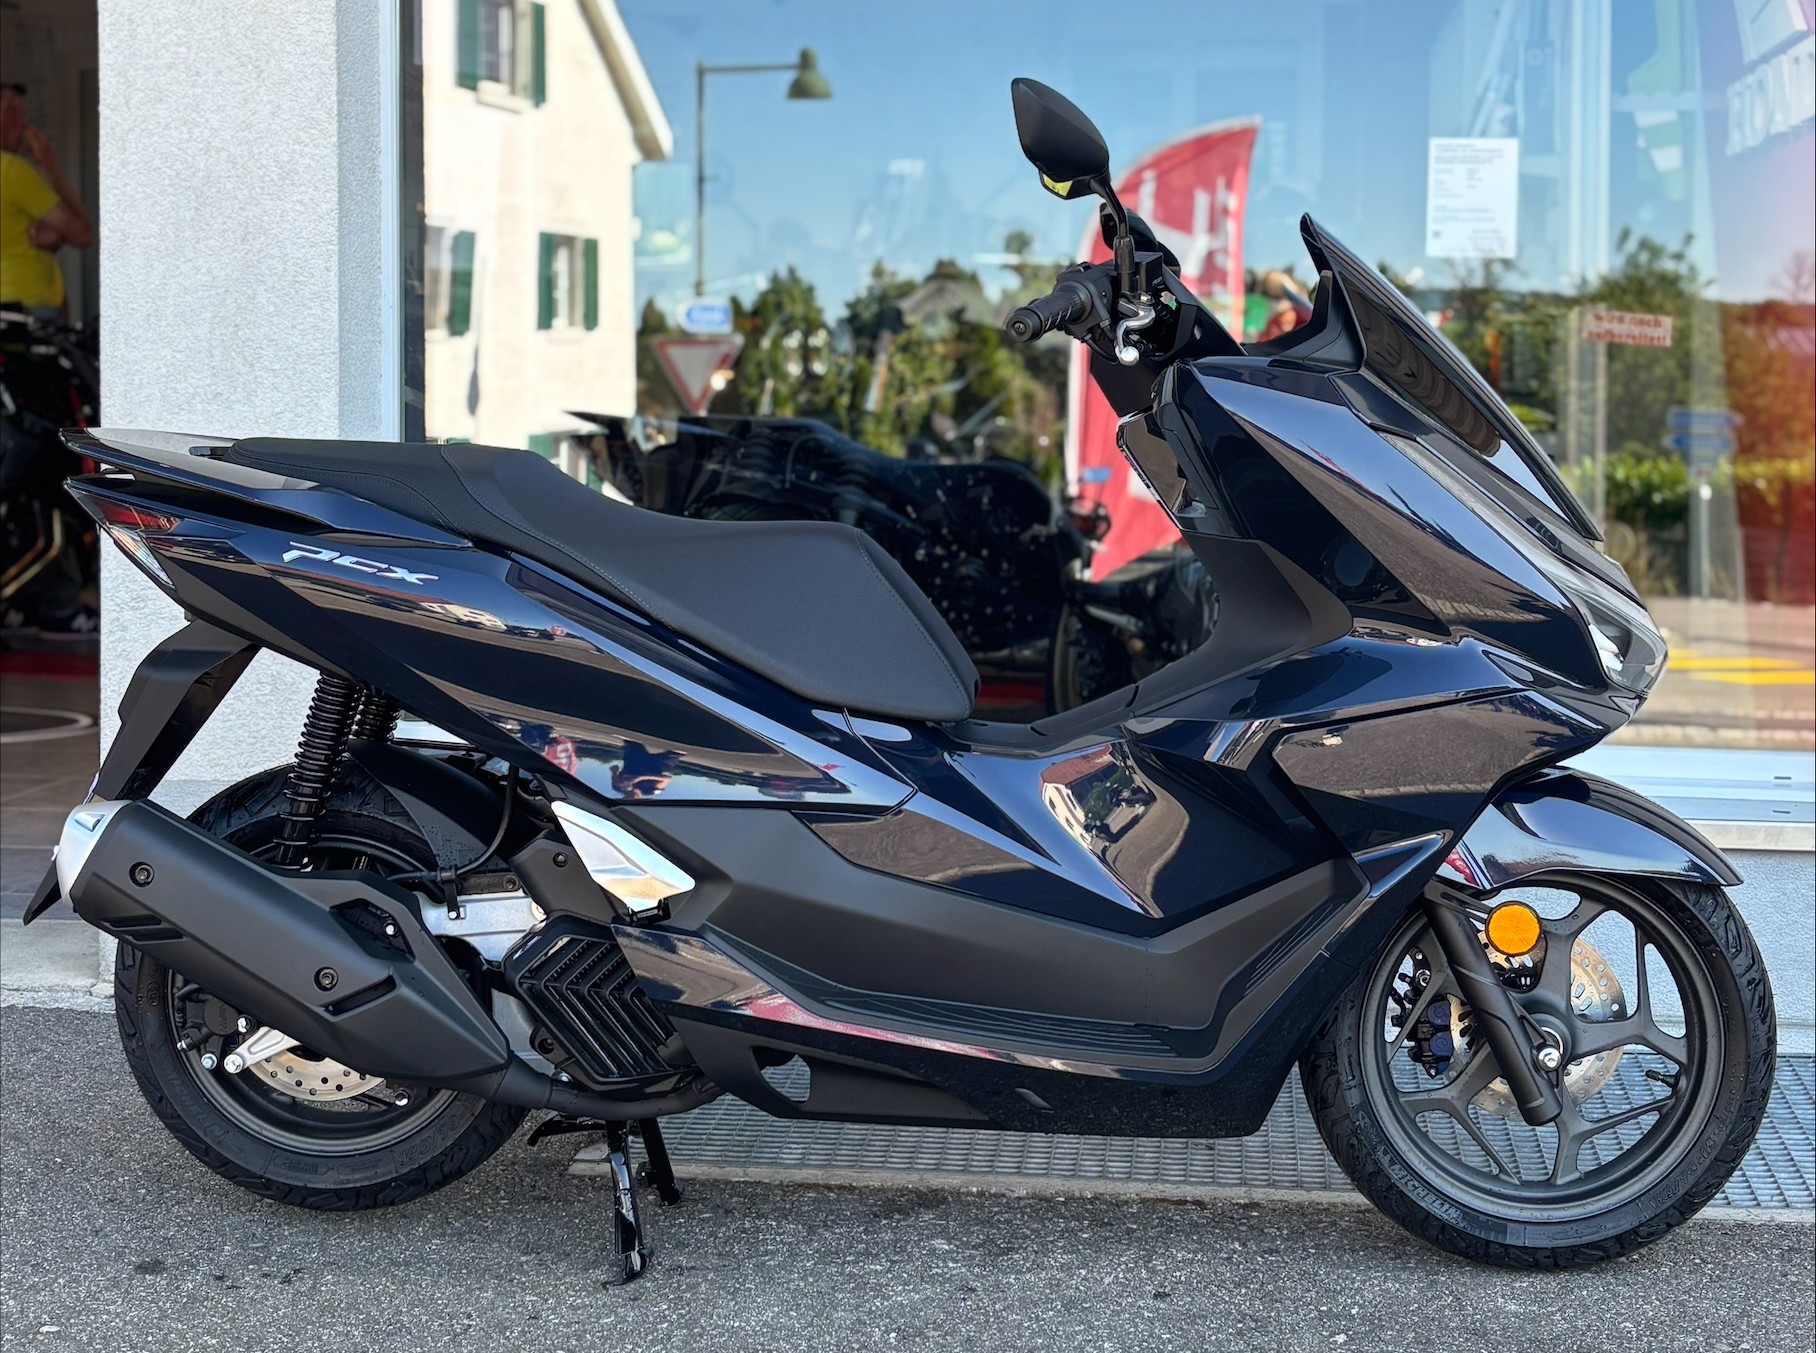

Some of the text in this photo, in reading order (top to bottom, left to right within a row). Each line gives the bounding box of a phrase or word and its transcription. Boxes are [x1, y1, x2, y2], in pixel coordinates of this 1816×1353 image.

[1594, 313, 1662, 328] wird noch
[282, 541, 439, 585] PCX
[1389, 1164, 1463, 1222] MICHELIN
